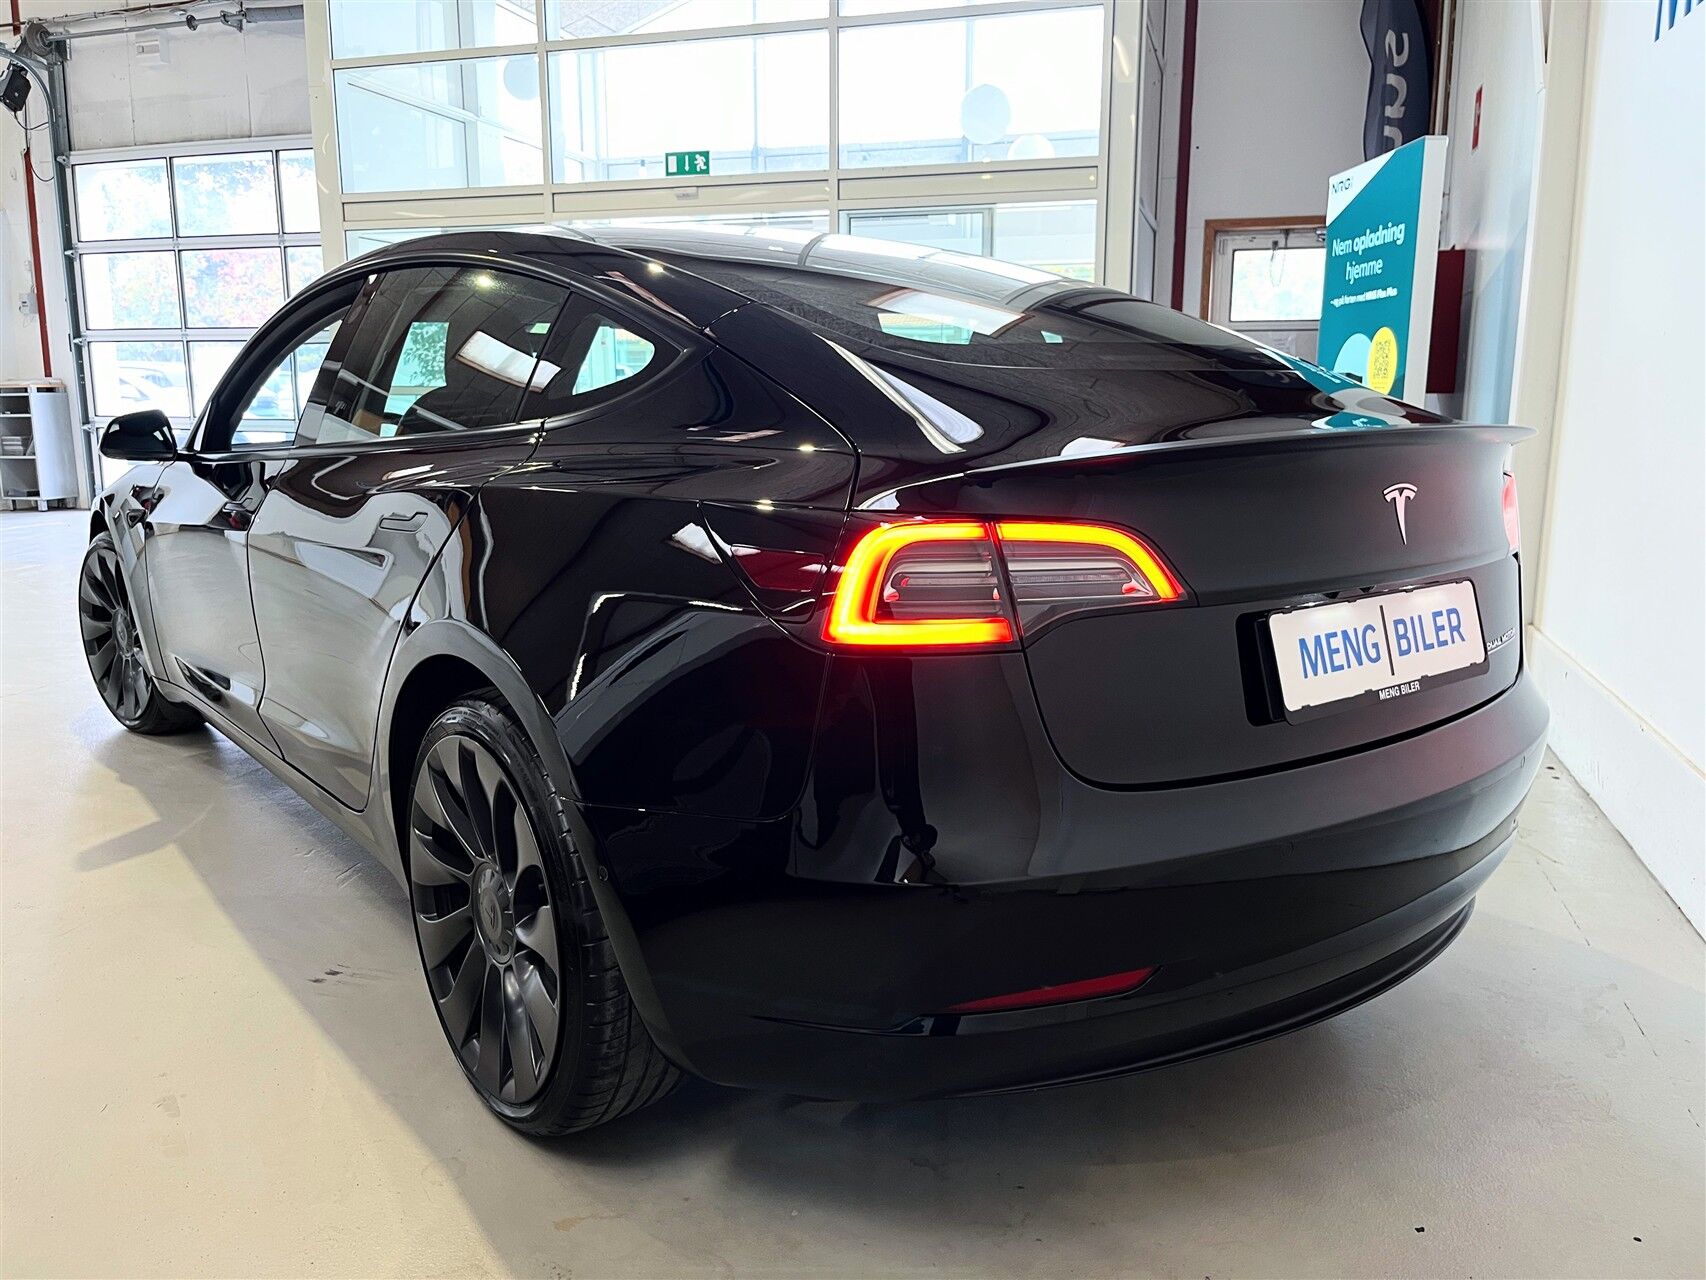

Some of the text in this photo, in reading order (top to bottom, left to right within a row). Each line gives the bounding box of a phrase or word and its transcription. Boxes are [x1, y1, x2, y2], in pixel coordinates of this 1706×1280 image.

[1332, 221, 1406, 257] Nem opladning
[1345, 259, 1383, 285] hjemme
[1298, 607, 1466, 679] MENG BILER
[1378, 681, 1421, 701] MENG BILER
